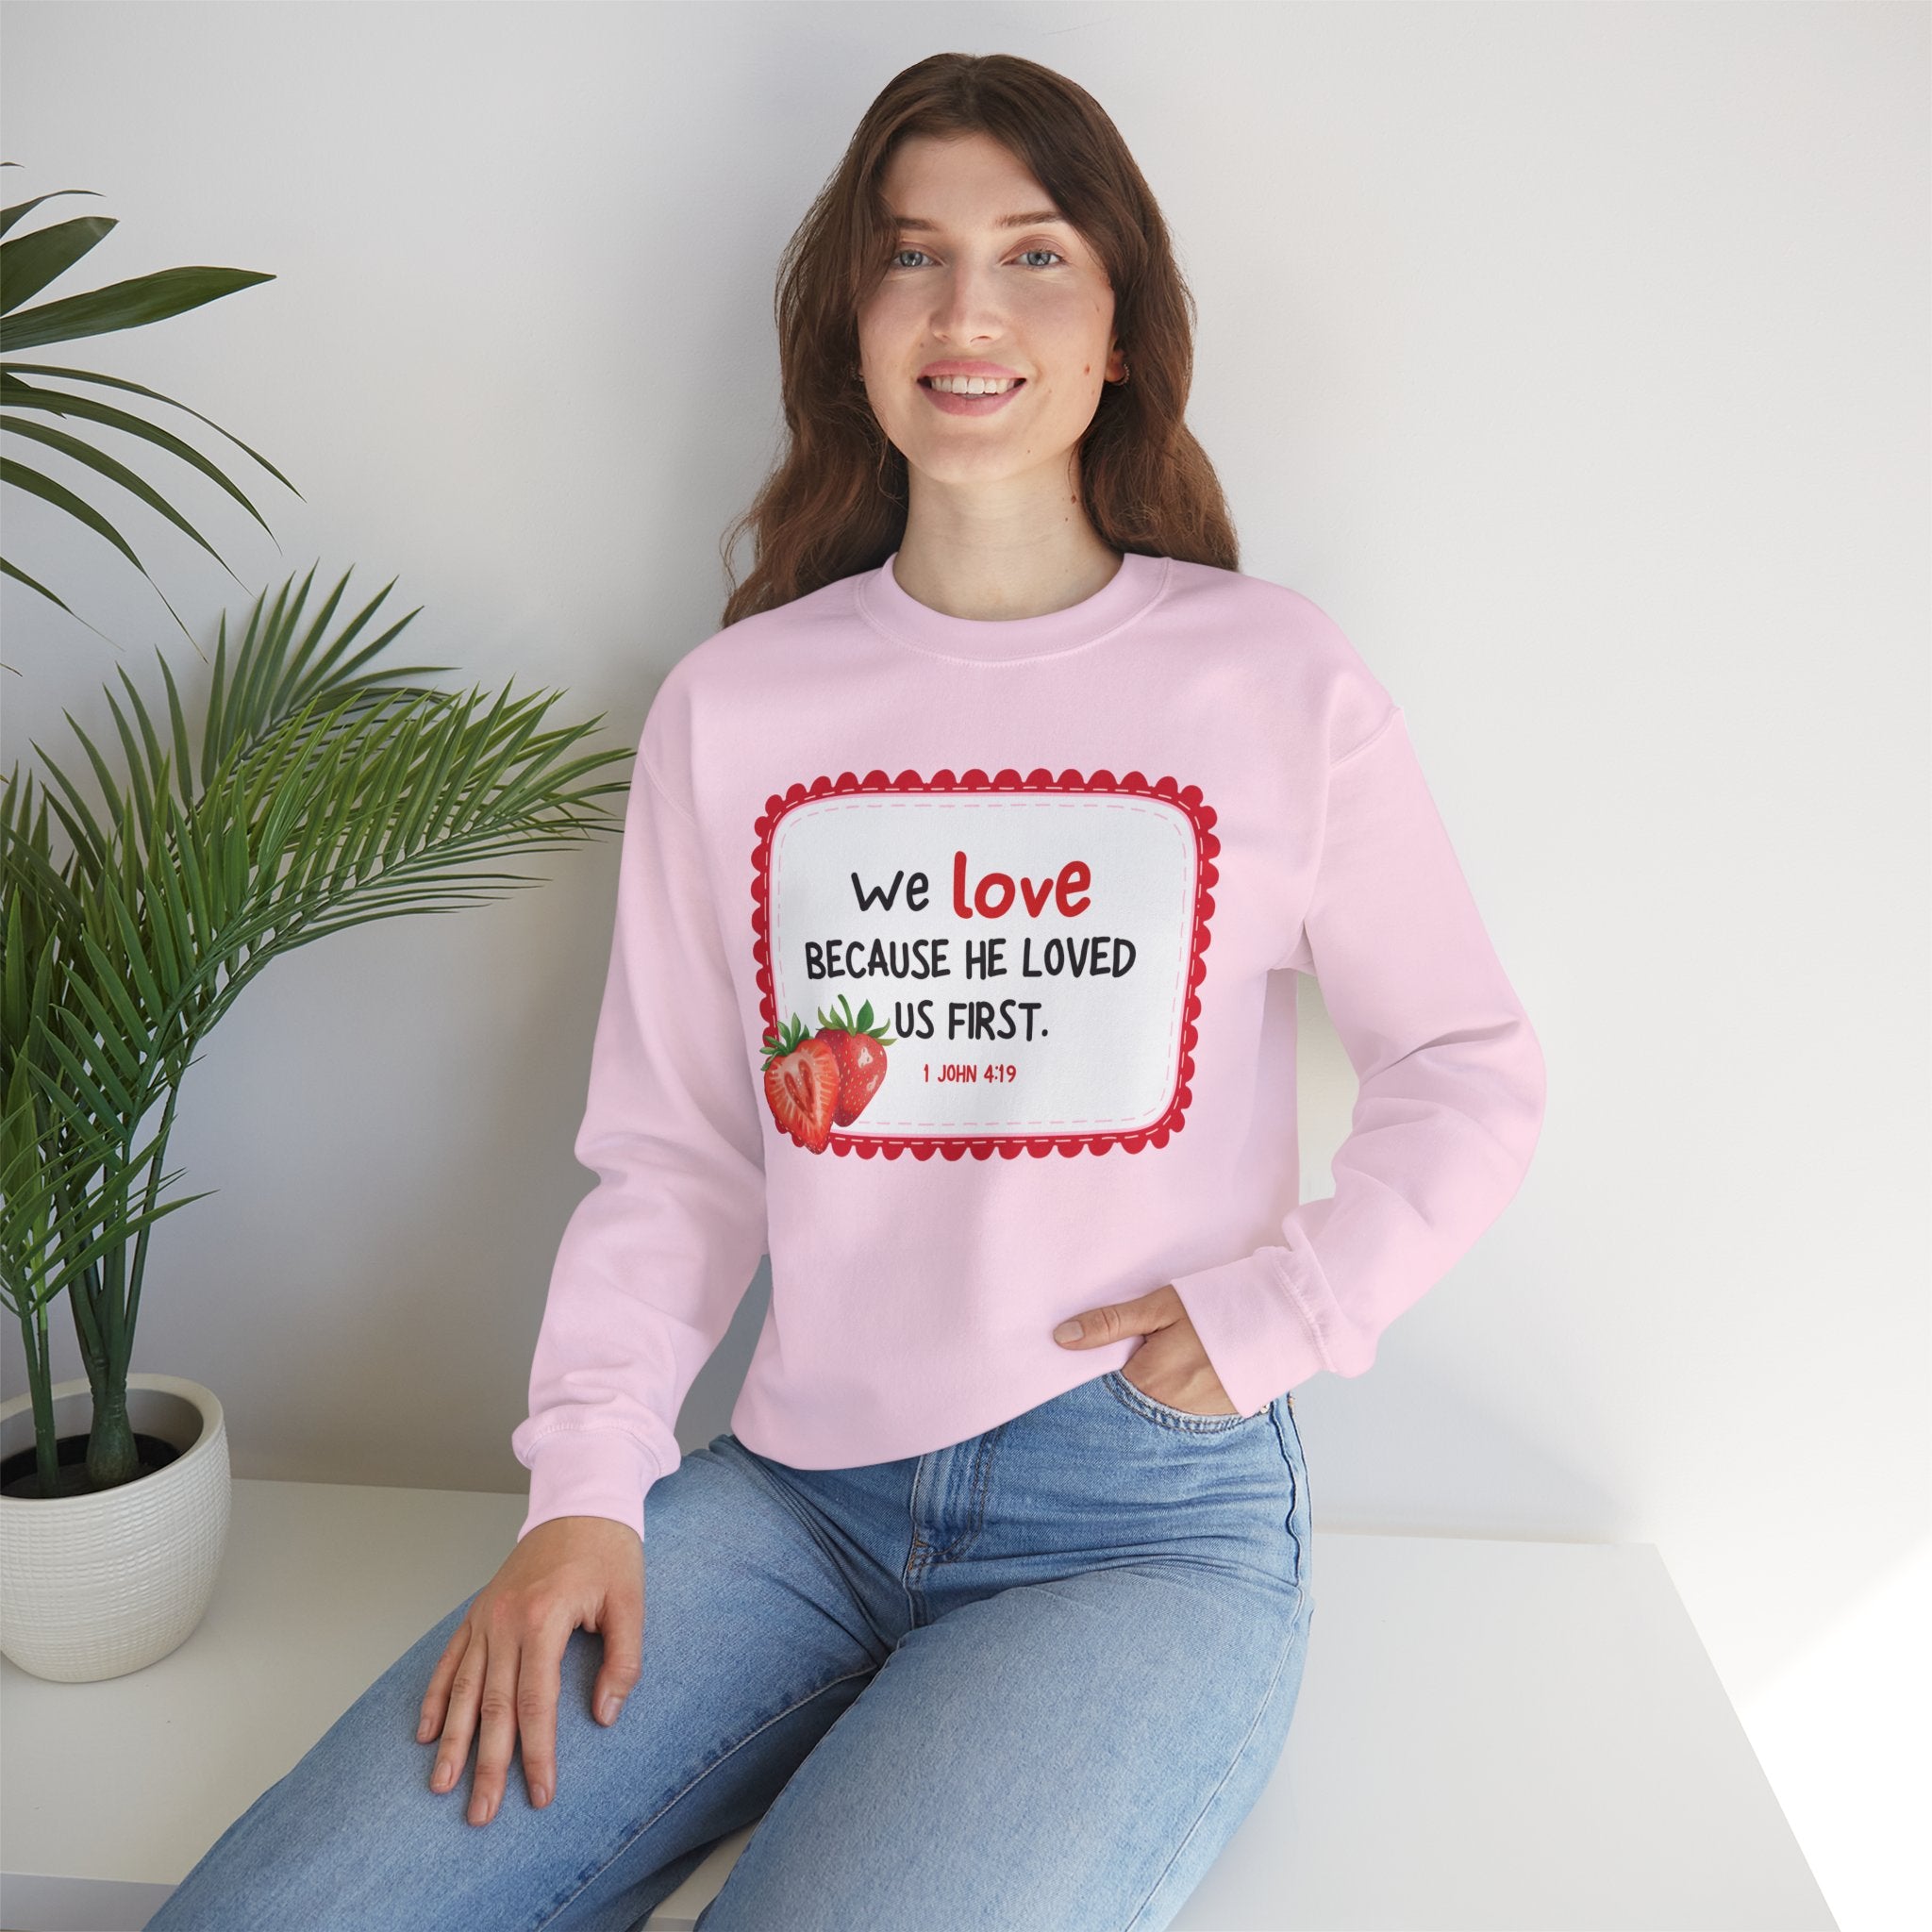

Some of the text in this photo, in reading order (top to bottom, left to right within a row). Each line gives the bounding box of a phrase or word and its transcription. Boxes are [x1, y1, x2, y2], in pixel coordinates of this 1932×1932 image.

[850, 850, 1092, 920] we love
[805, 936, 1137, 981] BECAUSE HE LOVED
[894, 998, 1049, 1041] US FIRST.
[924, 1064, 1017, 1084] 1 JOHN 4:19
